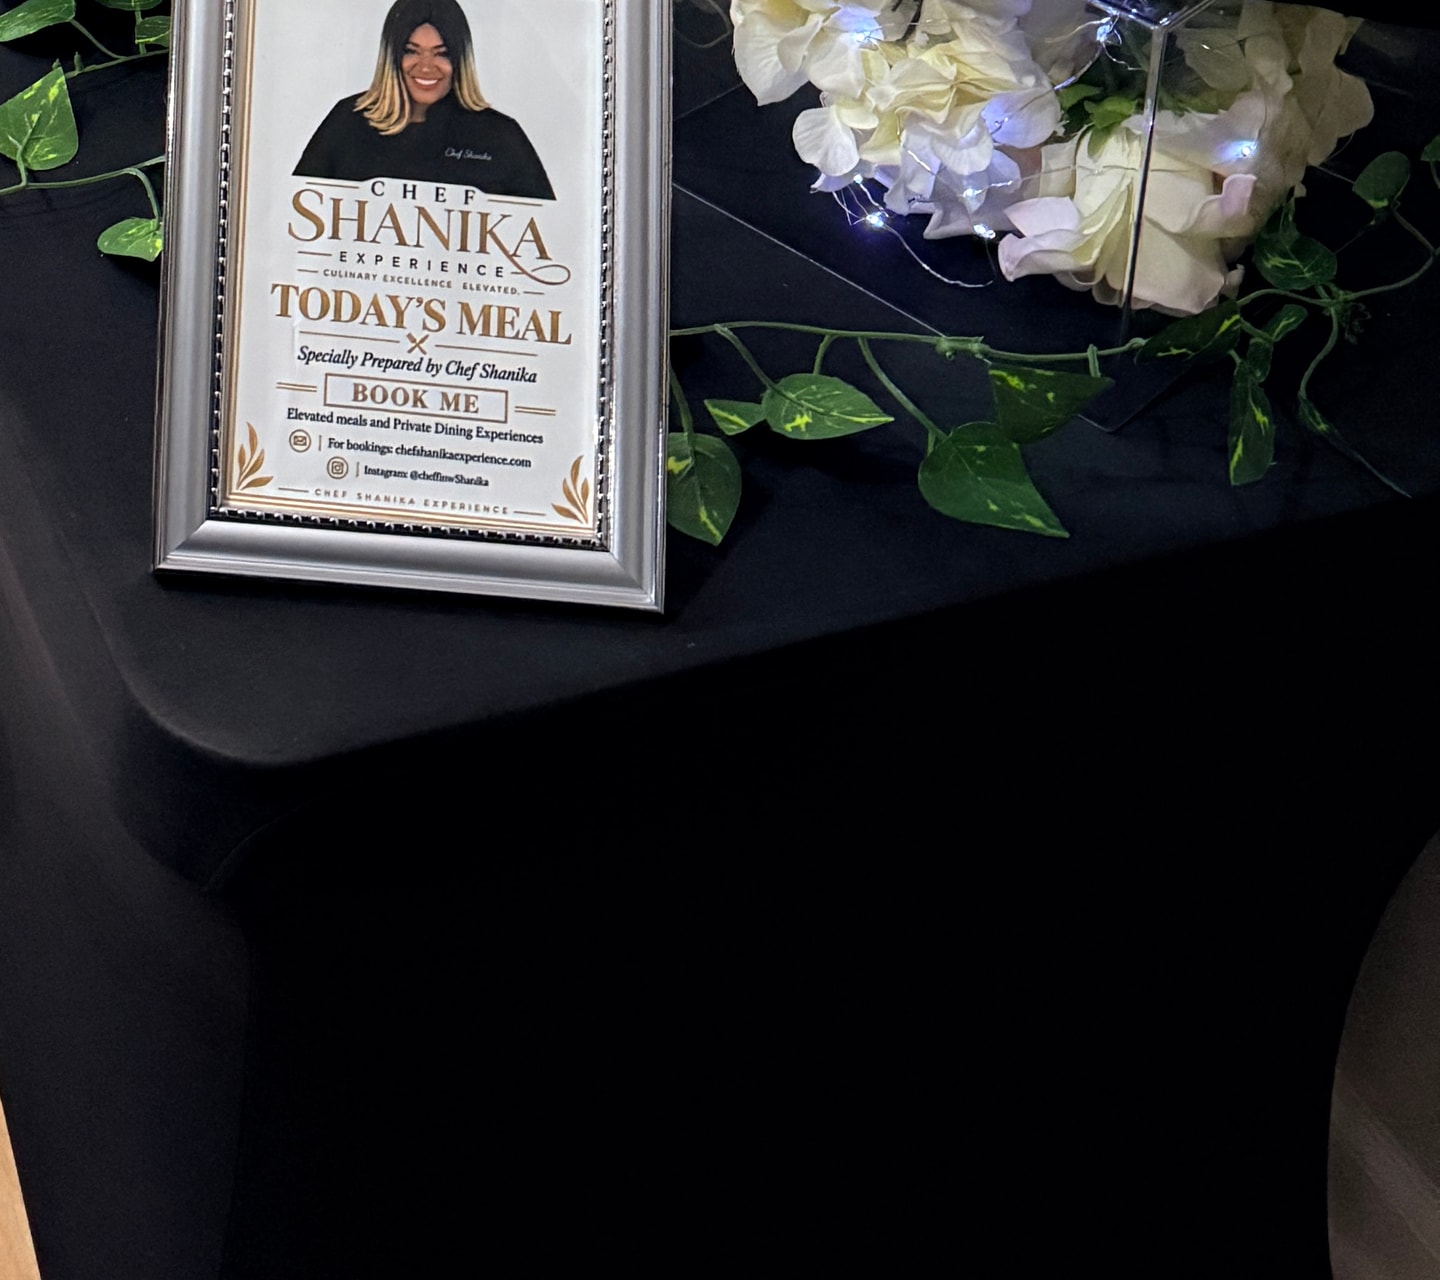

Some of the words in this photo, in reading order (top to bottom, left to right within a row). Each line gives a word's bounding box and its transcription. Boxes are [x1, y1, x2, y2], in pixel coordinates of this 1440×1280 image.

[371, 180, 477, 205] CHEF
[288, 189, 571, 285] SHANIKA
[339, 251, 504, 278] EXPERIENCE
[323, 268, 378, 281] CULINARY
[383, 274, 453, 289] EXCELLENCE
[462, 281, 520, 296] ELEVATED.
[271, 283, 446, 333] TODAY'S
[457, 301, 572, 345] MEAL
[297, 345, 359, 368] Specially
[360, 352, 422, 374] Prepared
[425, 355, 442, 377] by
[445, 359, 482, 382] Chef
[481, 363, 537, 383] Shanika
[351, 383, 429, 409] BOOK
[440, 391, 480, 414] ME
[287, 408, 334, 424] Elevated
[336, 413, 368, 427] meals
[369, 415, 390, 430] and
[393, 418, 432, 433] Private
[434, 422, 473, 440] Dining
[475, 426, 544, 444] Experiences
[327, 438, 344, 450] For
[346, 439, 393, 456] bookings:
[395, 444, 532, 468] chefshanikaexperience.com
[364, 465, 408, 480] Instagram:
[314, 488, 348, 499] CHEF
[357, 492, 415, 505] SHANIKA
[423, 498, 509, 515] EXPERIENCE
